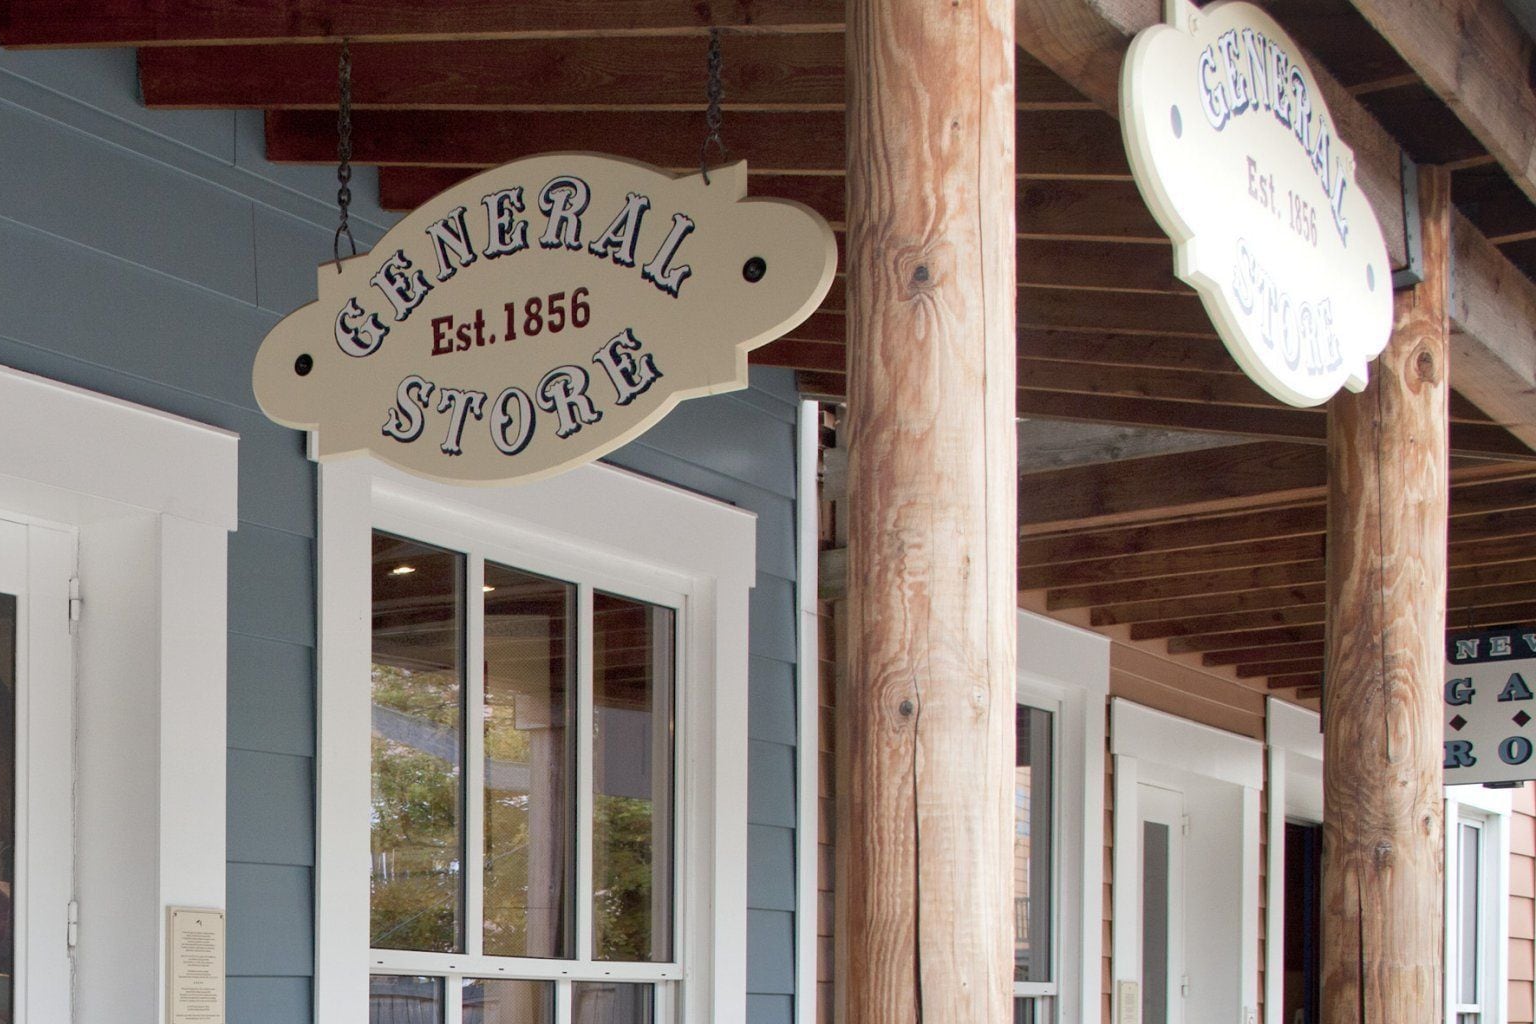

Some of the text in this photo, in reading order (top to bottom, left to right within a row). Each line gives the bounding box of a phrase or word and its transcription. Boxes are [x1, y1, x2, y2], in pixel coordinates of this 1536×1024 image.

[1198, 28, 1348, 248] GENERAL
[334, 175, 696, 358] GENERAL
[1288, 189, 1318, 248] 1856
[1232, 236, 1344, 376] STORE
[381, 327, 664, 457] STORE
